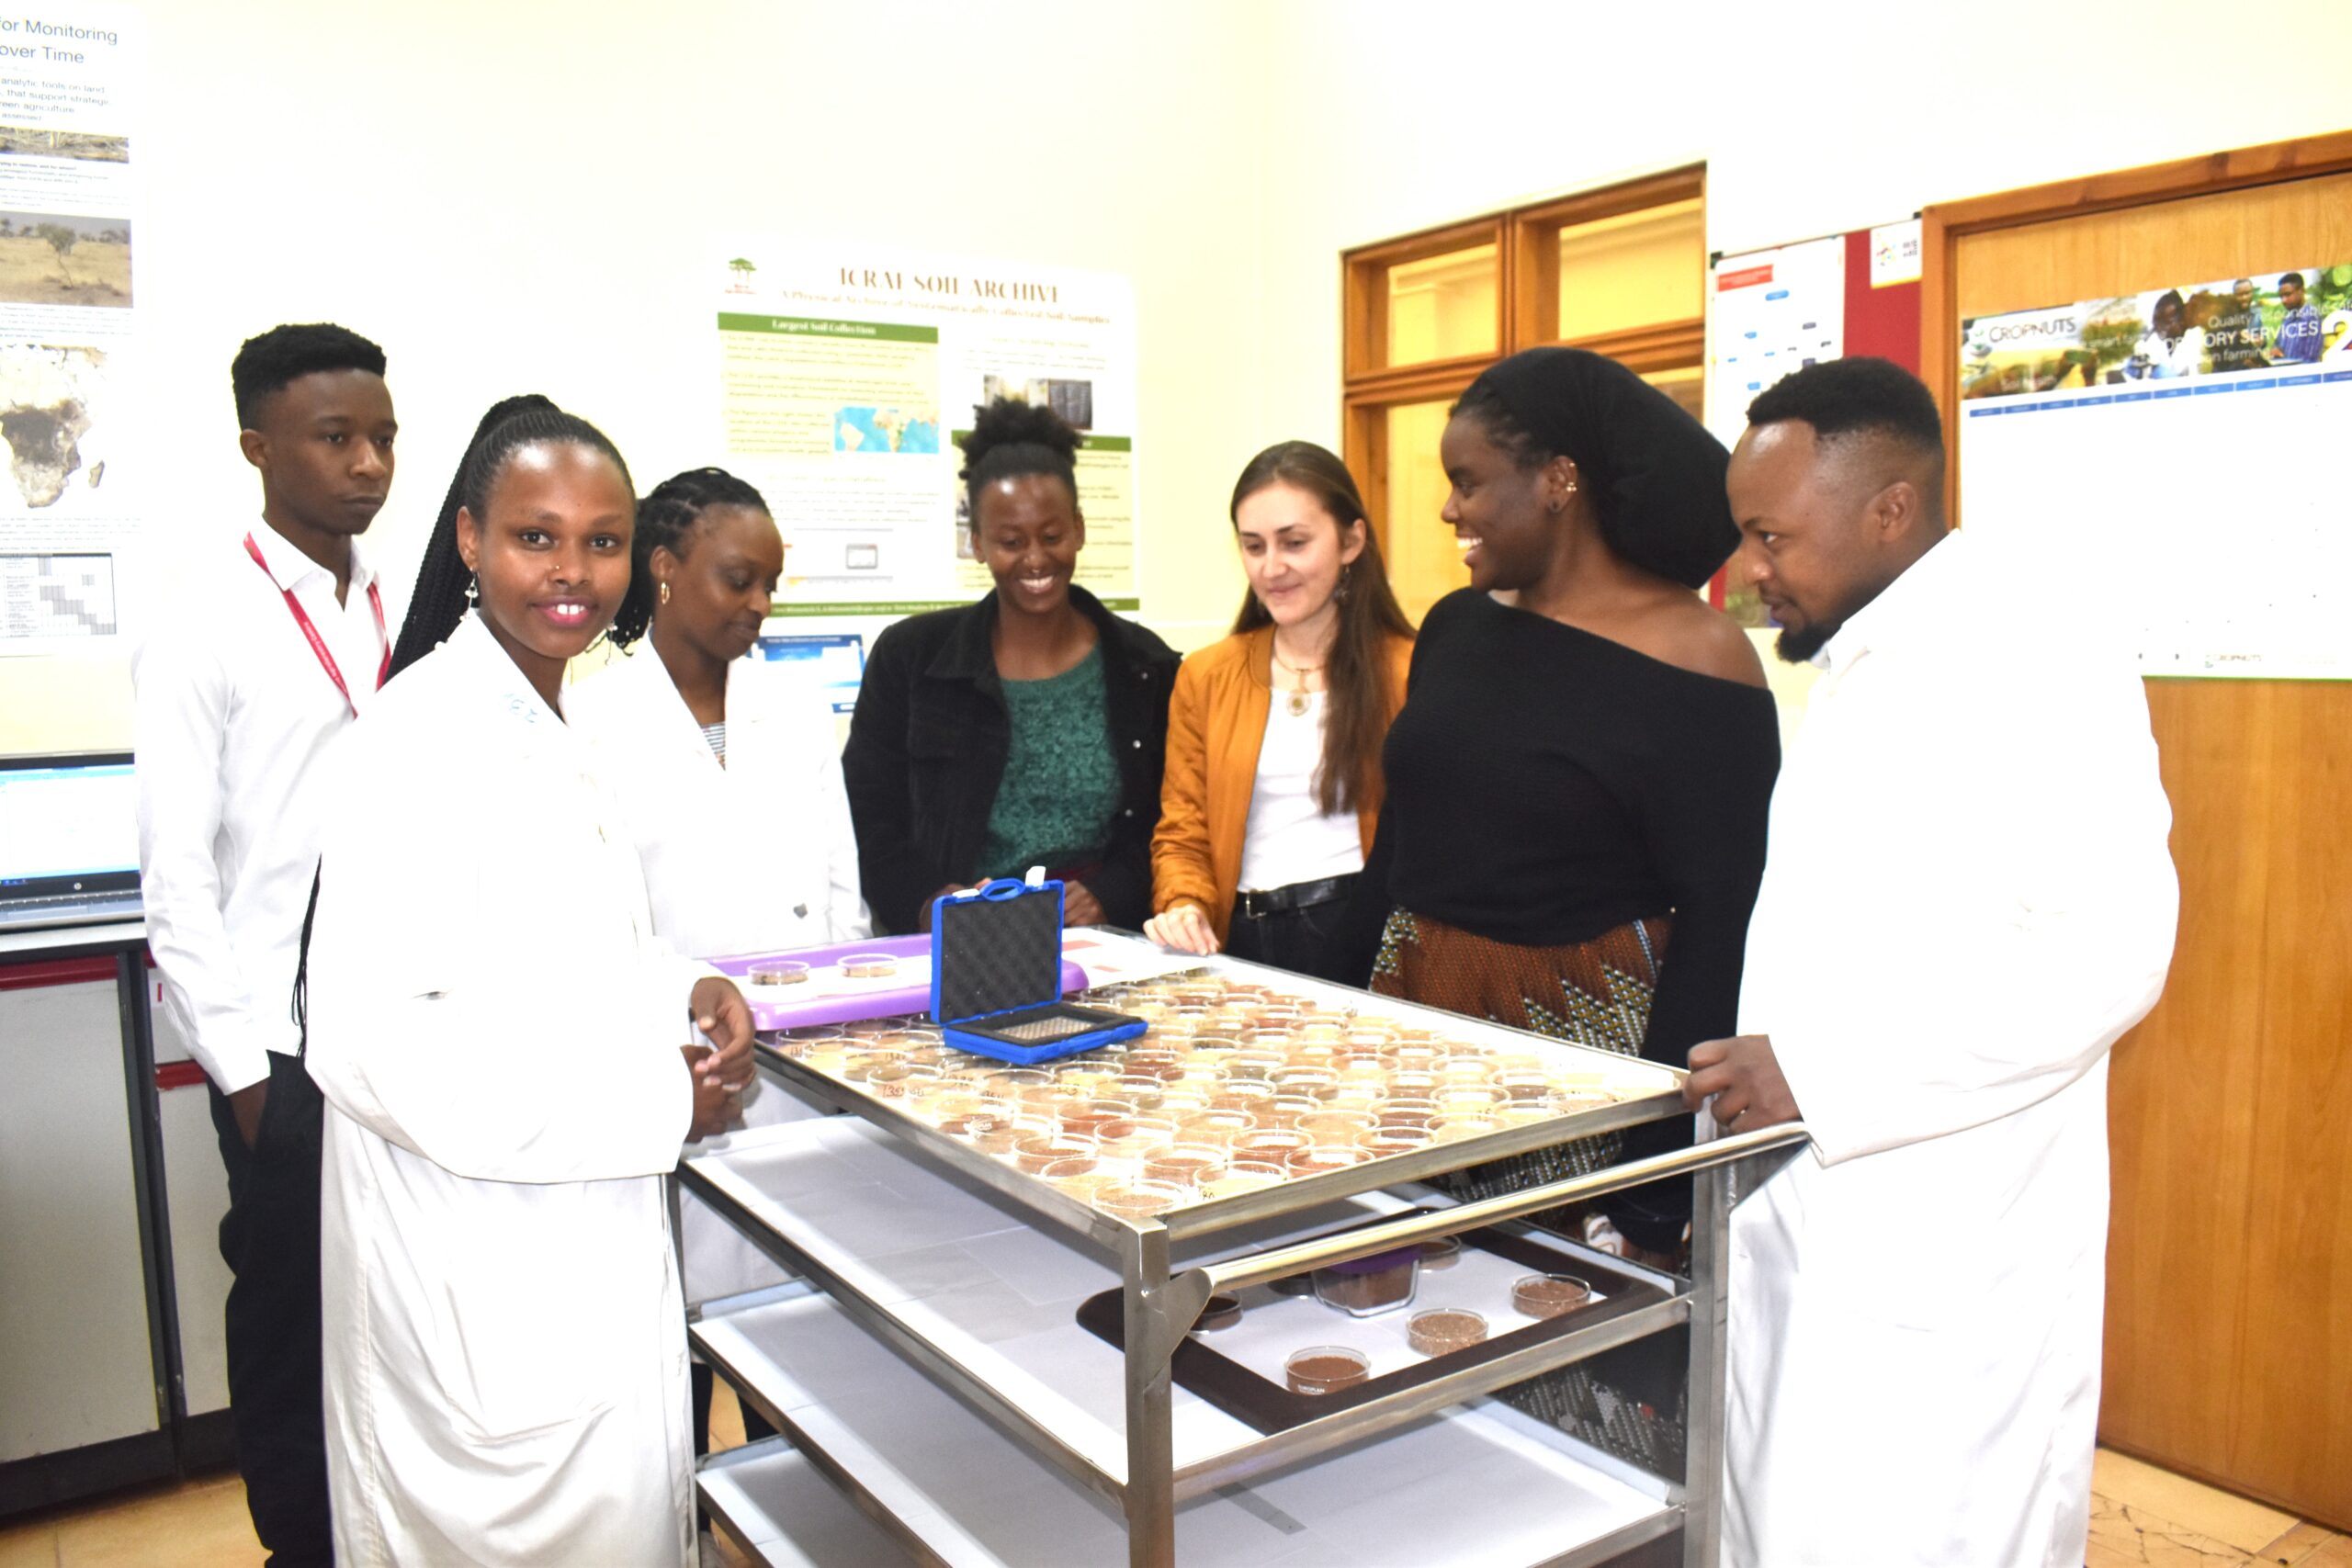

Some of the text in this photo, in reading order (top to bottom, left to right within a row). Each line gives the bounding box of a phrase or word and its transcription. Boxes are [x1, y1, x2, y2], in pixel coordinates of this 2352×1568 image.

[26, 19, 118, 45] Monitoring
[42, 46, 85, 63] Time
[773, 319, 876, 335] Largest Soil Collection
[1989, 317, 2076, 343] CROPNUTS
[2240, 321, 2320, 345] SERVICES
